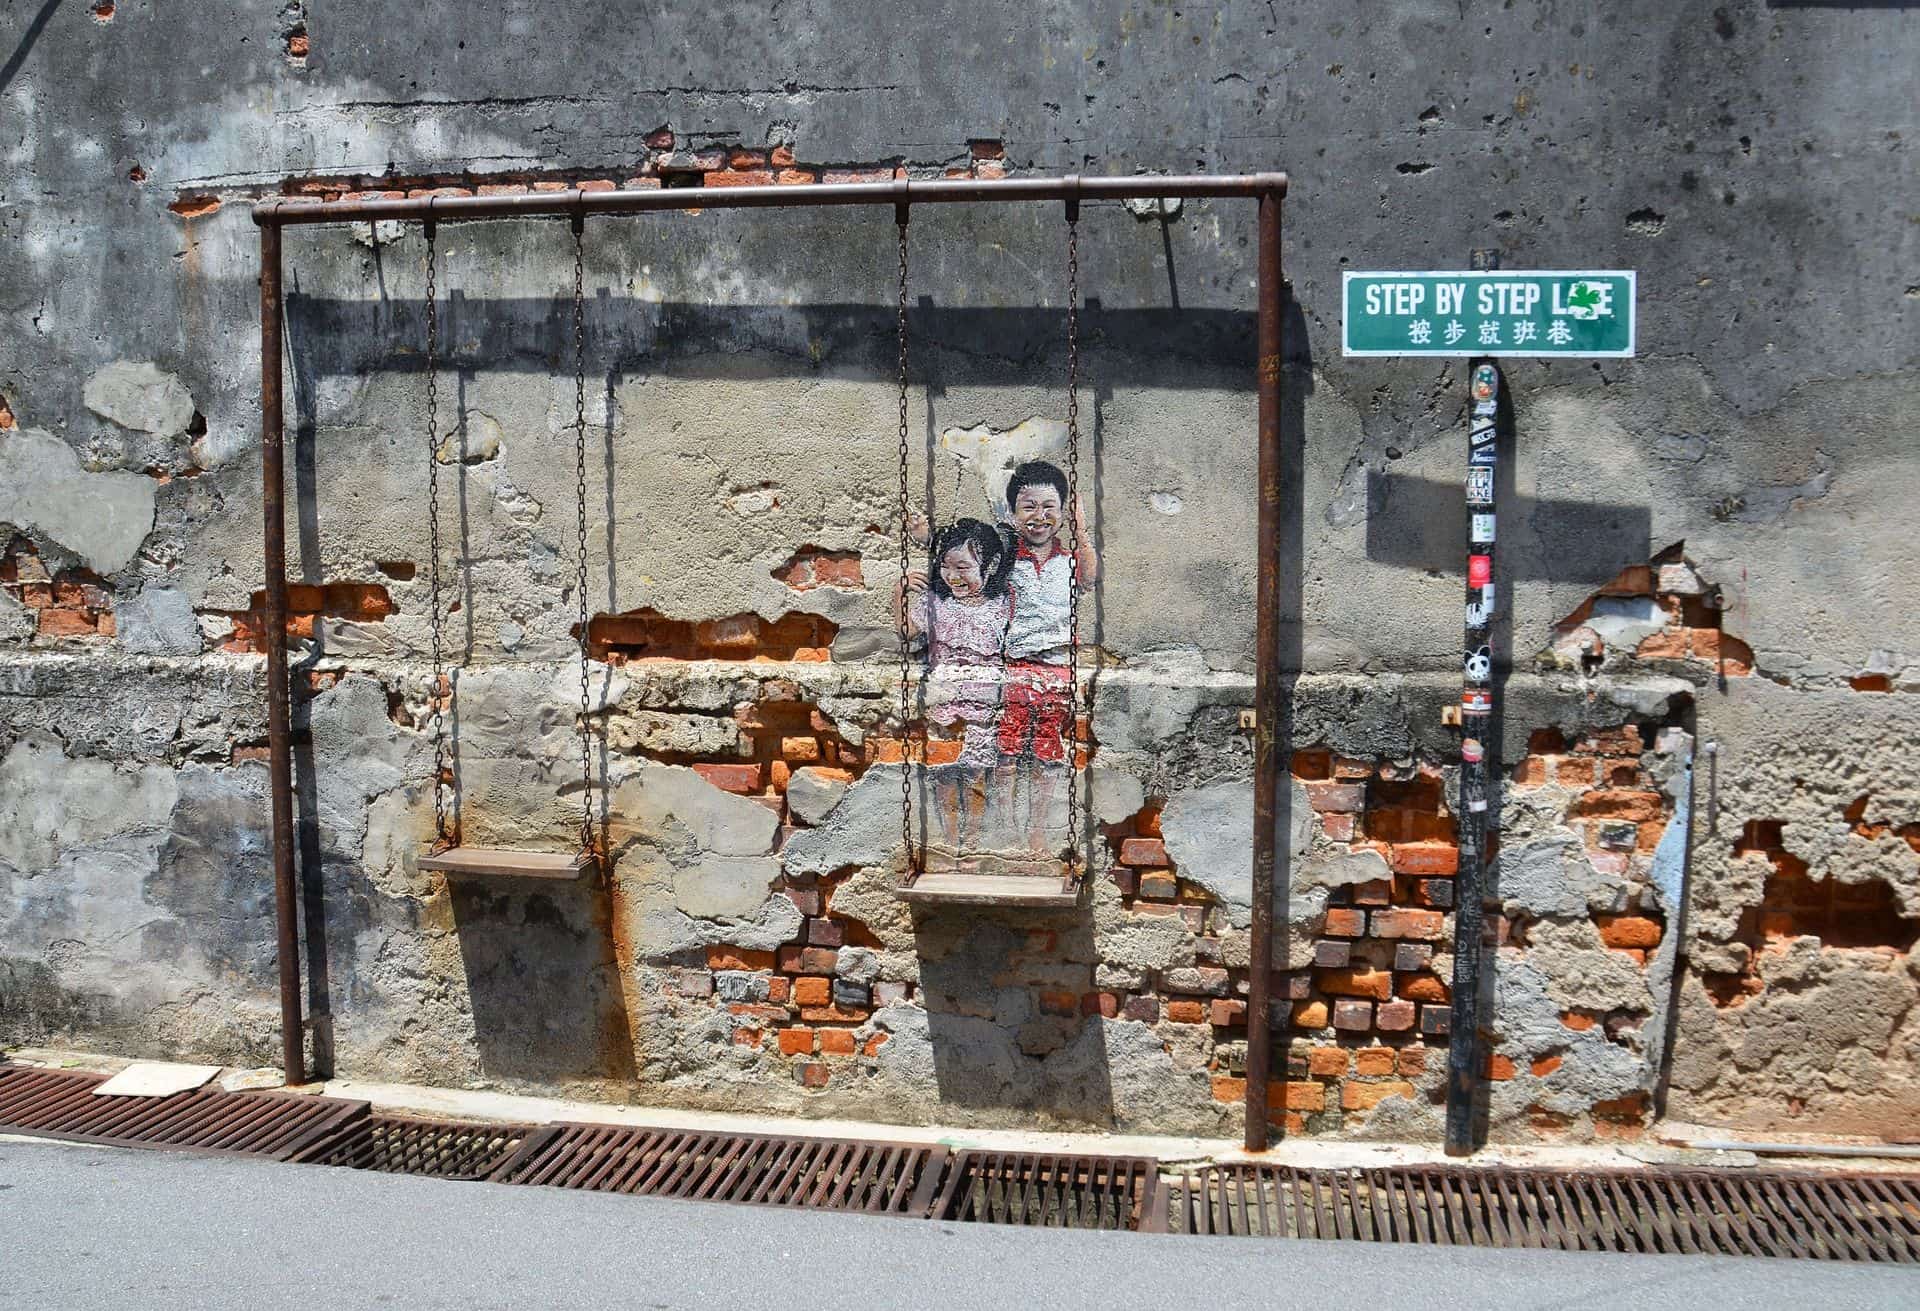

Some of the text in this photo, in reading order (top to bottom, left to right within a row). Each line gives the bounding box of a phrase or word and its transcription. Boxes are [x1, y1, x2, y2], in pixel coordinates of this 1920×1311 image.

[1366, 282, 1613, 316] STEP BY STEP LE
[1408, 319, 1574, 345] 按步就班巷
